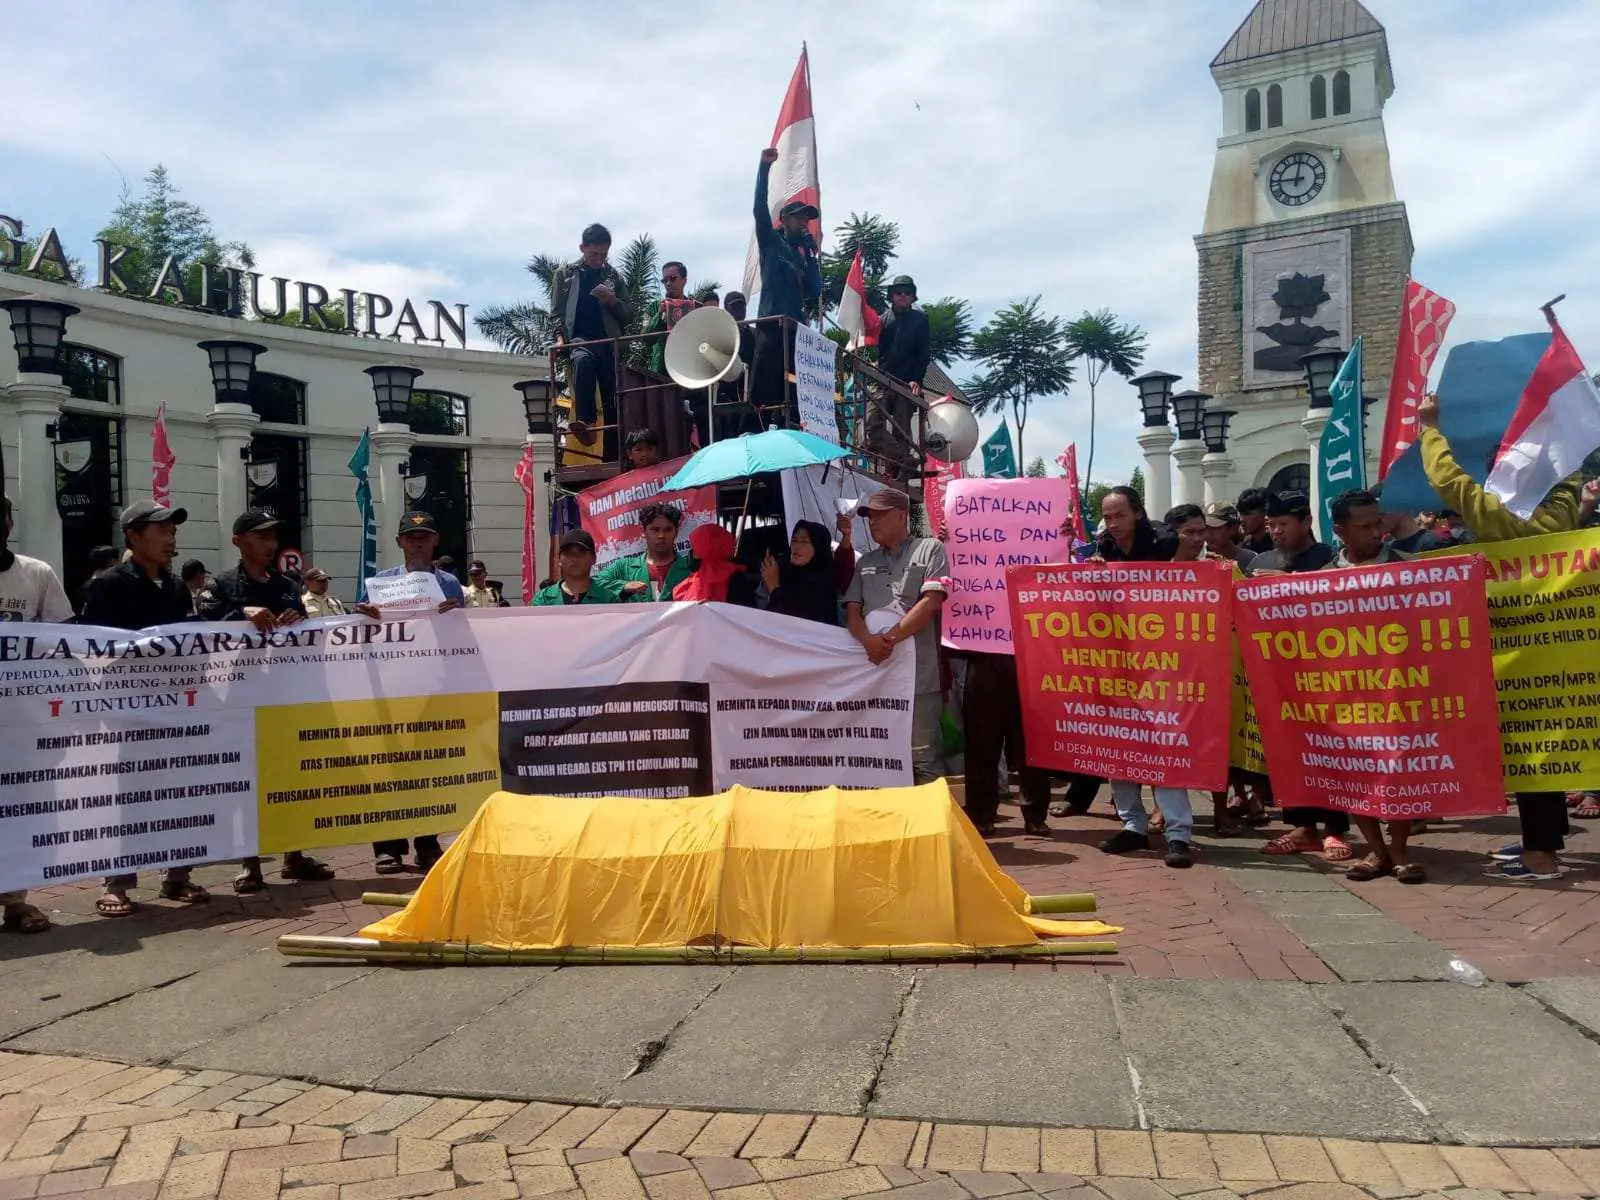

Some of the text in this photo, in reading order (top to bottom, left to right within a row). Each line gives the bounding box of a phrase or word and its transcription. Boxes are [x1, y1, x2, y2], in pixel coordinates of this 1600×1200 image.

[93, 237, 469, 347] KAHURIPAN
[589, 497, 613, 517] HAM
[954, 495, 1052, 516] BATALKAN
[1020, 527, 1058, 542] DAN
[952, 553, 987, 567] IZIN
[1036, 568, 1197, 584] PAK PRESIDEN KITA
[1236, 563, 1473, 602] GUBERNUR JAWA BARAT
[1018, 589, 1221, 604] BP PRABOWO SUBIANTO
[1258, 590, 1452, 621] KANG DEDI MULYADI
[1524, 591, 1551, 606] DAN
[951, 602, 996, 620] SUAP
[1548, 606, 1596, 622] JAWAB
[1023, 611, 1217, 642] TOLONG !!!
[1251, 616, 1472, 660] TOLONG !!!
[86, 621, 416, 660] MASYARAKAT SIPIL
[1500, 634, 1532, 649] HULU
[1534, 631, 1550, 646] KE
[1552, 628, 1586, 644] HILIR
[66, 665, 126, 678] ADVOKAT,
[129, 662, 198, 675] KELOMPOK
[229, 655, 299, 668] MAHASISWA,
[368, 649, 406, 660] MAJLIS
[1061, 647, 1180, 671] HENTIKAN
[16, 672, 246, 696] KECAMATAN PARUNG KAB. BOGOR
[1040, 674, 1206, 703] ALAT BERAT !!!
[1294, 665, 1430, 692] HENTIKAN
[1534, 669, 1597, 690] DPR/MPR
[72, 692, 179, 714] TUNTUTAN
[501, 699, 709, 722] MEMINTA SATGAS TANAH MENGUSUT TUNTAS
[716, 697, 910, 713] MEMINTA KEPADA DINAS KAB. BOGOR MENCABUT
[1064, 702, 1180, 725] YANG MERUSAK
[1280, 700, 1330, 723] ALAT
[1334, 699, 1423, 725] BERAT
[1429, 695, 1467, 721] !!!
[1509, 696, 1565, 714] KONFLIK
[298, 718, 466, 742] MEMINTA DI ADILINYA PT KURIPAN RAYA
[743, 726, 889, 740] IZIN AMDAL DAN IZIN CUT FILL ATAS
[1055, 719, 1189, 747] LINGKUNGAN KITA
[1565, 715, 1598, 729] DARI
[37, 724, 210, 750] MEMINTA KEPADA PEMERINTAH AGAR
[524, 728, 690, 748] PARA PENJAHAT AGRARIA YANG TERLIBAT
[1304, 732, 1439, 752] YANG MERUSAK
[1504, 740, 1532, 755] DAN
[1535, 738, 1589, 753] KEPADA
[300, 746, 466, 772] ATAS TINDAKAN PERUSAKAN ALAM DAN
[729, 755, 903, 771] RENCANA PEMBANGUNAN PT. KURIPAN RAYA
[1054, 740, 1191, 769] DI DESA IWUL KECAMATAN
[1301, 752, 1455, 775] LINGKUNGAN KITA
[0, 751, 241, 785] MEMPERTAHANKAN FUNGSI LAHAN PERTANIAN DAN
[517, 757, 699, 777] DI TANAH NEGARA EKS CIMULANG DAN
[1074, 758, 1165, 783] PARUNG BOGOR
[1509, 762, 1536, 776] DAN
[1540, 761, 1581, 776] SIDAK
[81, 780, 250, 810] TANAH NEGARA UNTUK KEPENTINGAN
[267, 769, 498, 805] PERUSAKAN PERTANIAN MASYARAKAT SECARA BRUTAL
[1304, 775, 1461, 799] DI DESA IWUL KECAMATAN
[1328, 794, 1432, 816] PARUNG BOGOR
[32, 813, 215, 848] RAKYAT DEMI PROGRAM KEMANDIRIAN
[314, 816, 333, 830] DAN
[334, 812, 362, 828] TIDAK
[43, 845, 208, 880] EKONOMI DAN KETAHANAN PANGAN
